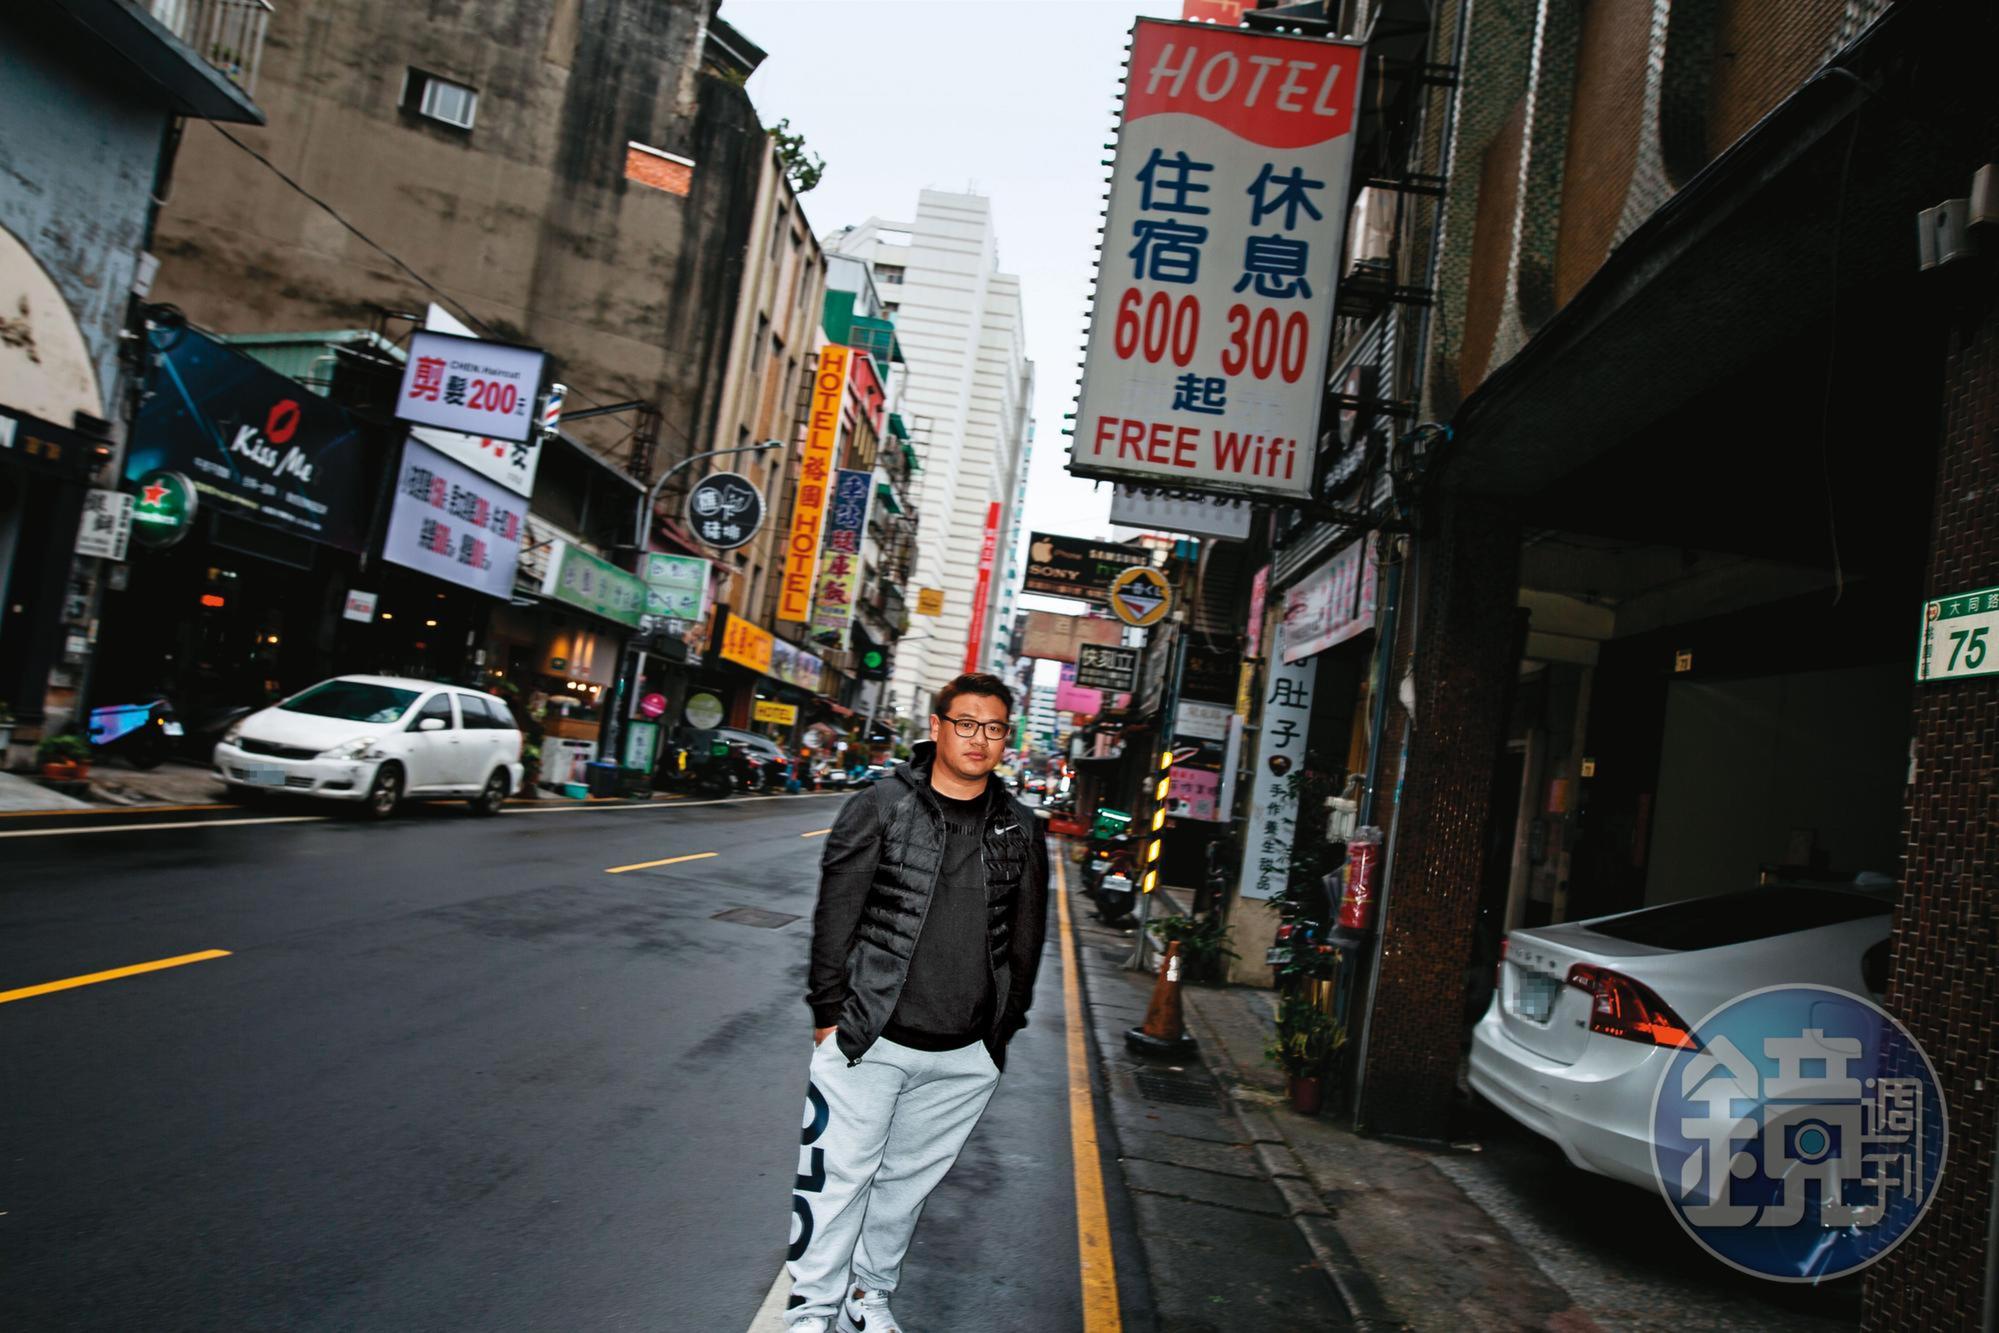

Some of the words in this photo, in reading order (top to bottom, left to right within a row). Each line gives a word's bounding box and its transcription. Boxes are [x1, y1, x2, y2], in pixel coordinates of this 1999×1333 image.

[1146, 43, 1342, 117] HOTEL
[1128, 147, 1215, 285] 住宿
[1233, 162, 1326, 301] 休息
[1113, 286, 1201, 368] 600
[1221, 302, 1310, 384] 300
[809, 352, 844, 451] HOTEL
[1171, 372, 1228, 416] 起
[230, 424, 279, 469] Kiss
[272, 445, 314, 483] Me
[1093, 415, 1202, 469] FREE
[1213, 429, 1297, 480] Wifi
[783, 513, 818, 614] HOTEL
[1028, 564, 1081, 580] SONY
[1949, 593, 1999, 617] 大同路
[1946, 625, 1991, 672] 75
[1267, 657, 1309, 749] 肚子
